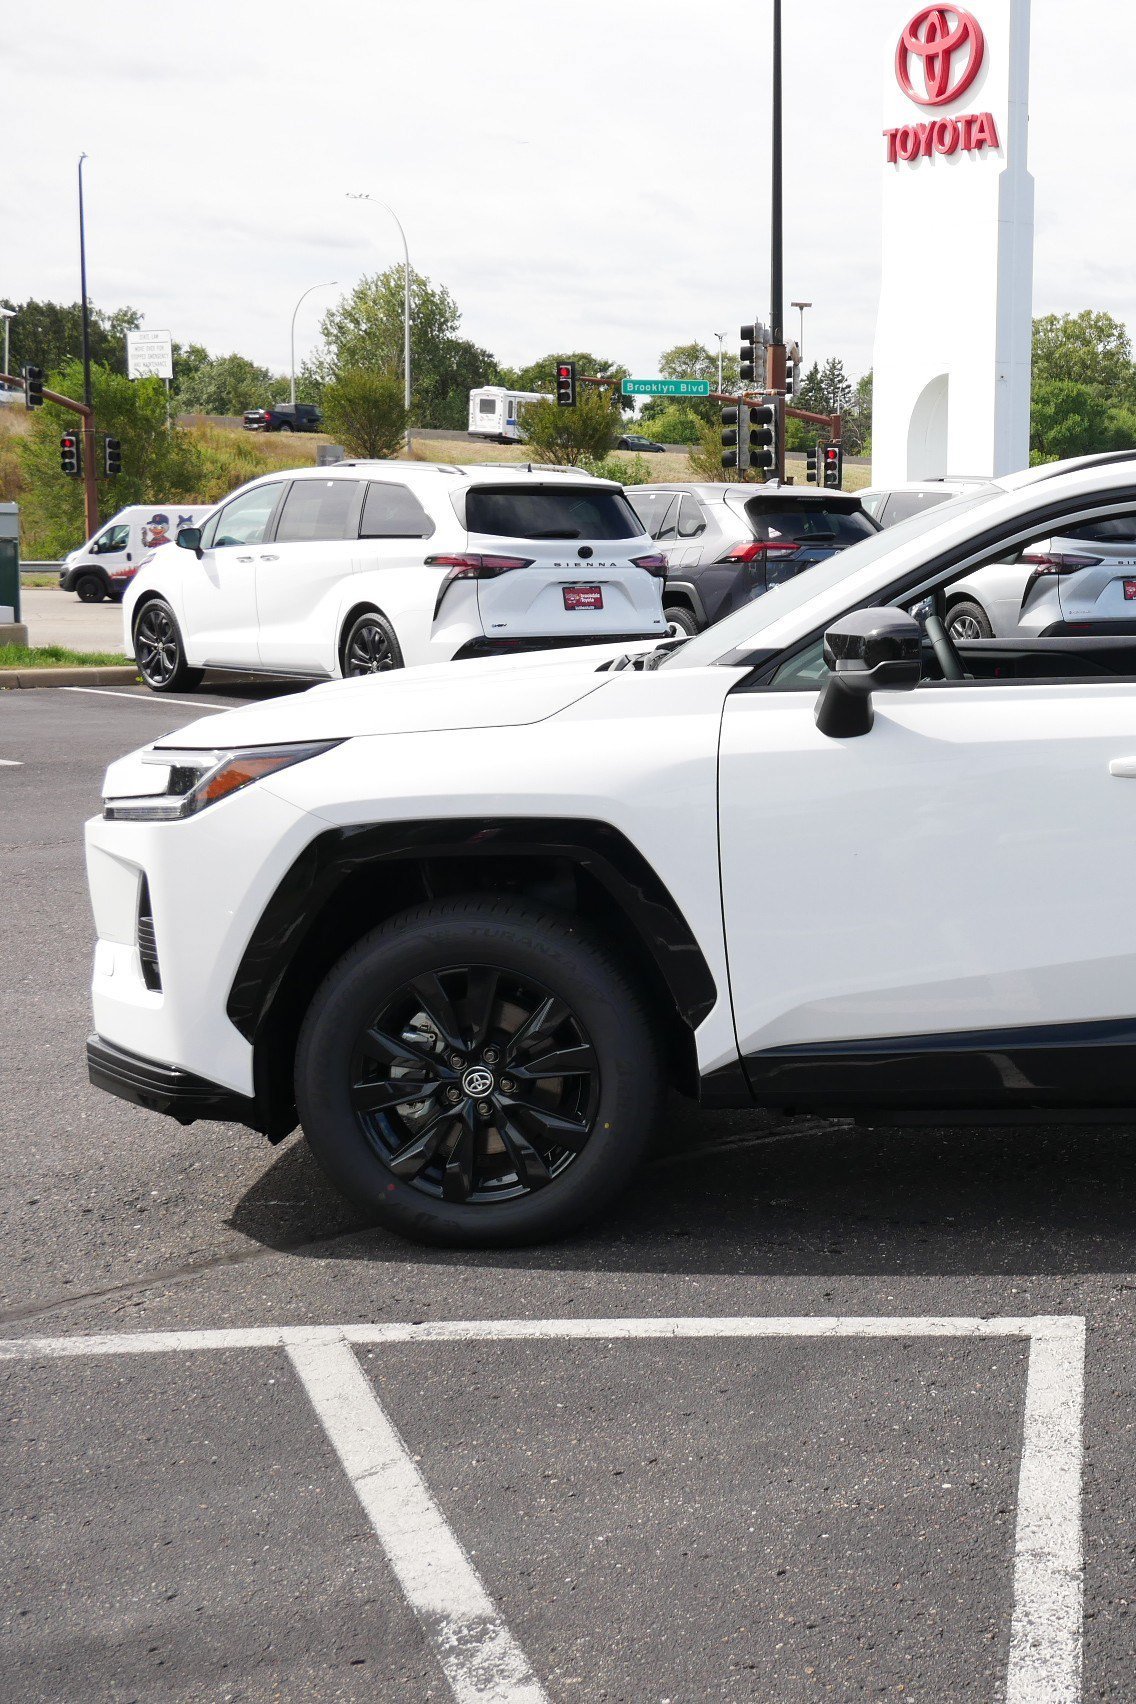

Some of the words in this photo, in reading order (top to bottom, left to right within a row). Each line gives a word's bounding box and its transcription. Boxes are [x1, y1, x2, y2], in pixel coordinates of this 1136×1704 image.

[883, 112, 999, 163] TOYOTA
[627, 383, 675, 393] Brooklyn
[680, 383, 704, 392] Blvd
